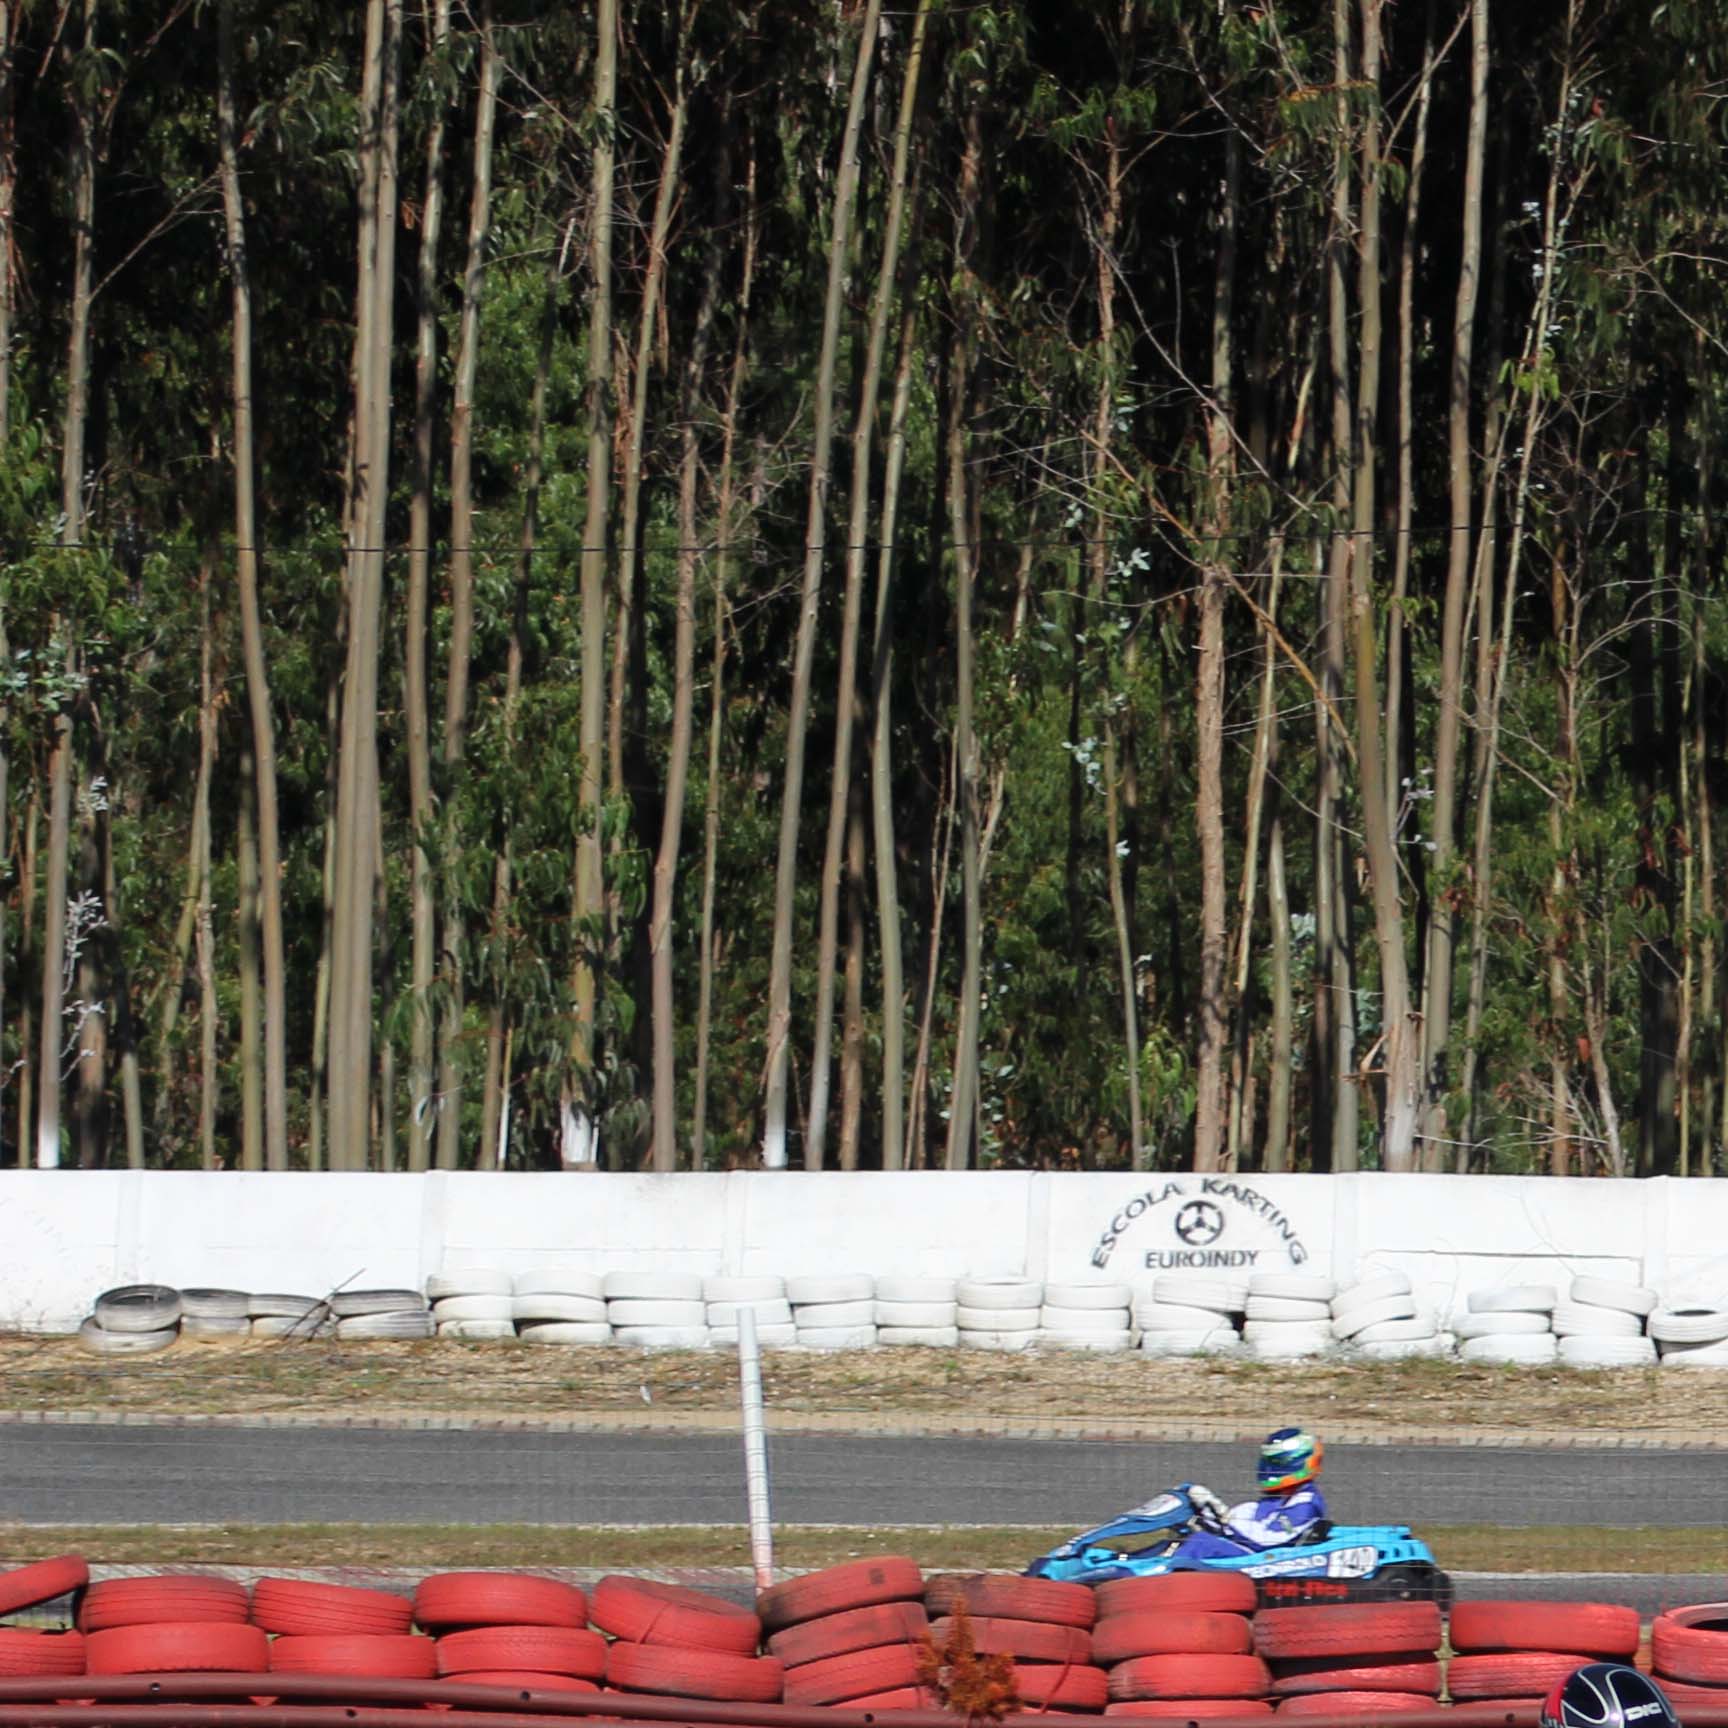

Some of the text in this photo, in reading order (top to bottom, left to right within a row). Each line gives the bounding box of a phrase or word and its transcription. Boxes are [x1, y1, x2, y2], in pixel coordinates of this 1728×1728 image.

[1090, 1177, 1309, 1270] ESCOLA KARTING
[1145, 1249, 1261, 1270] EUROINDY
